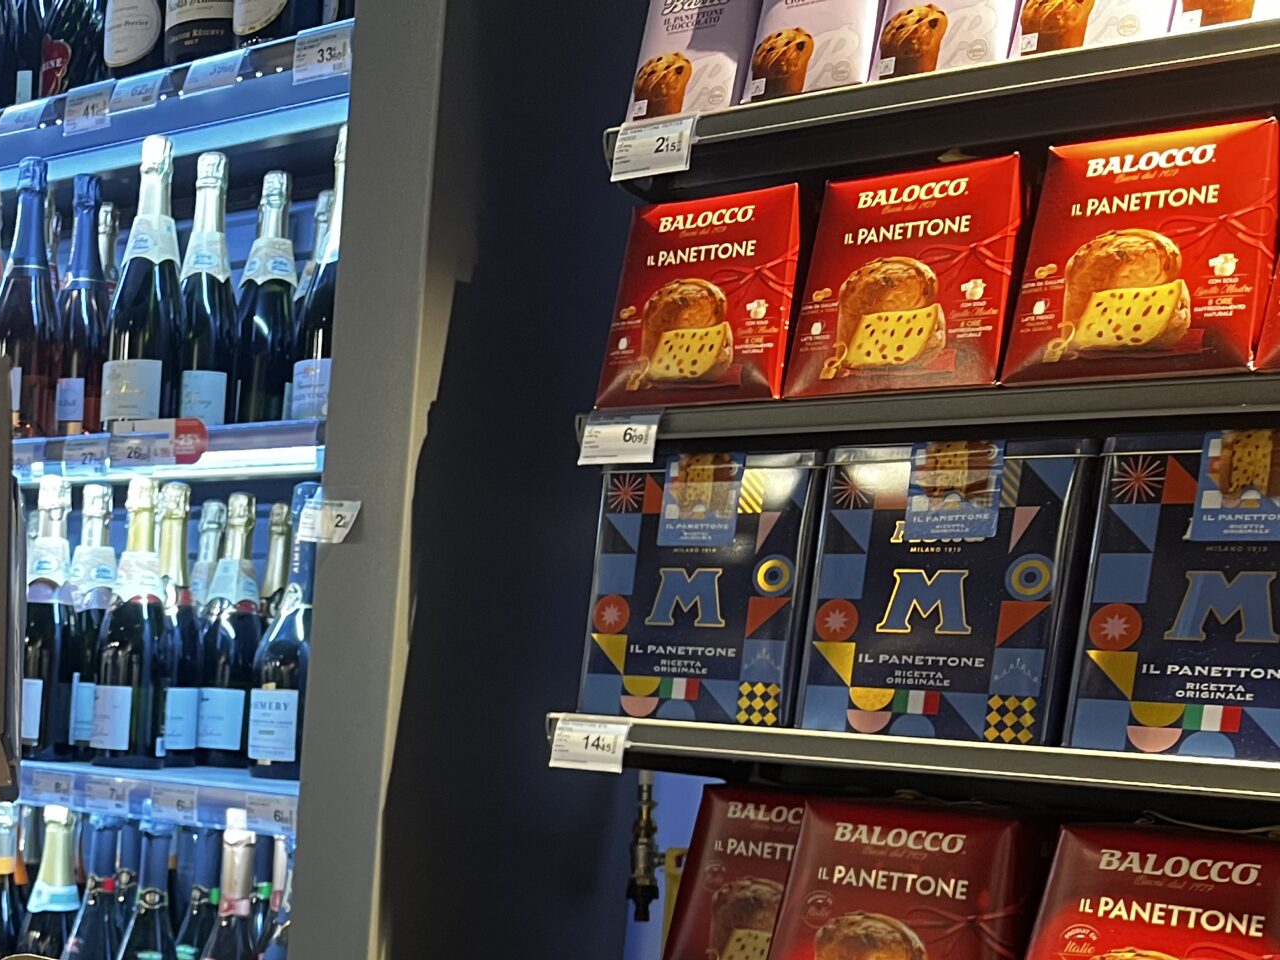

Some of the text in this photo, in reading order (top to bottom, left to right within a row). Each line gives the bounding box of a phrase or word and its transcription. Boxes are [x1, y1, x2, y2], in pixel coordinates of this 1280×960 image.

[1086, 144, 1217, 178] BALOCCO
[857, 178, 969, 209] BALOCCO
[1071, 184, 1220, 217] IL PANETTONE
[659, 205, 756, 233] BALOCCO
[844, 215, 972, 246] IL PANETTONE
[647, 240, 757, 267] IL PANETTONE
[926, 513, 991, 522] PANETTONE
[644, 567, 726, 628] M
[875, 568, 972, 635] M
[1163, 570, 1280, 644] M
[630, 644, 737, 658] IL PANETTONE
[660, 659, 702, 668] RICETTA
[858, 653, 985, 668] IL PANETTONE
[653, 666, 708, 675] ORIGINALE
[886, 676, 951, 687] ORIGINALE
[894, 669, 943, 679] RICETTA
[1141, 663, 1161, 675] IL
[1175, 690, 1255, 701] ORIGINALE
[1185, 682, 1246, 693] RICETTA
[727, 800, 804, 825] BALOC
[714, 838, 796, 862] IL PANETT
[834, 821, 967, 855] BALOCCO
[1098, 849, 1262, 886] BALOCCO
[818, 865, 969, 900] IL PANETTONE
[1079, 896, 1266, 938] IL PANETTONE
